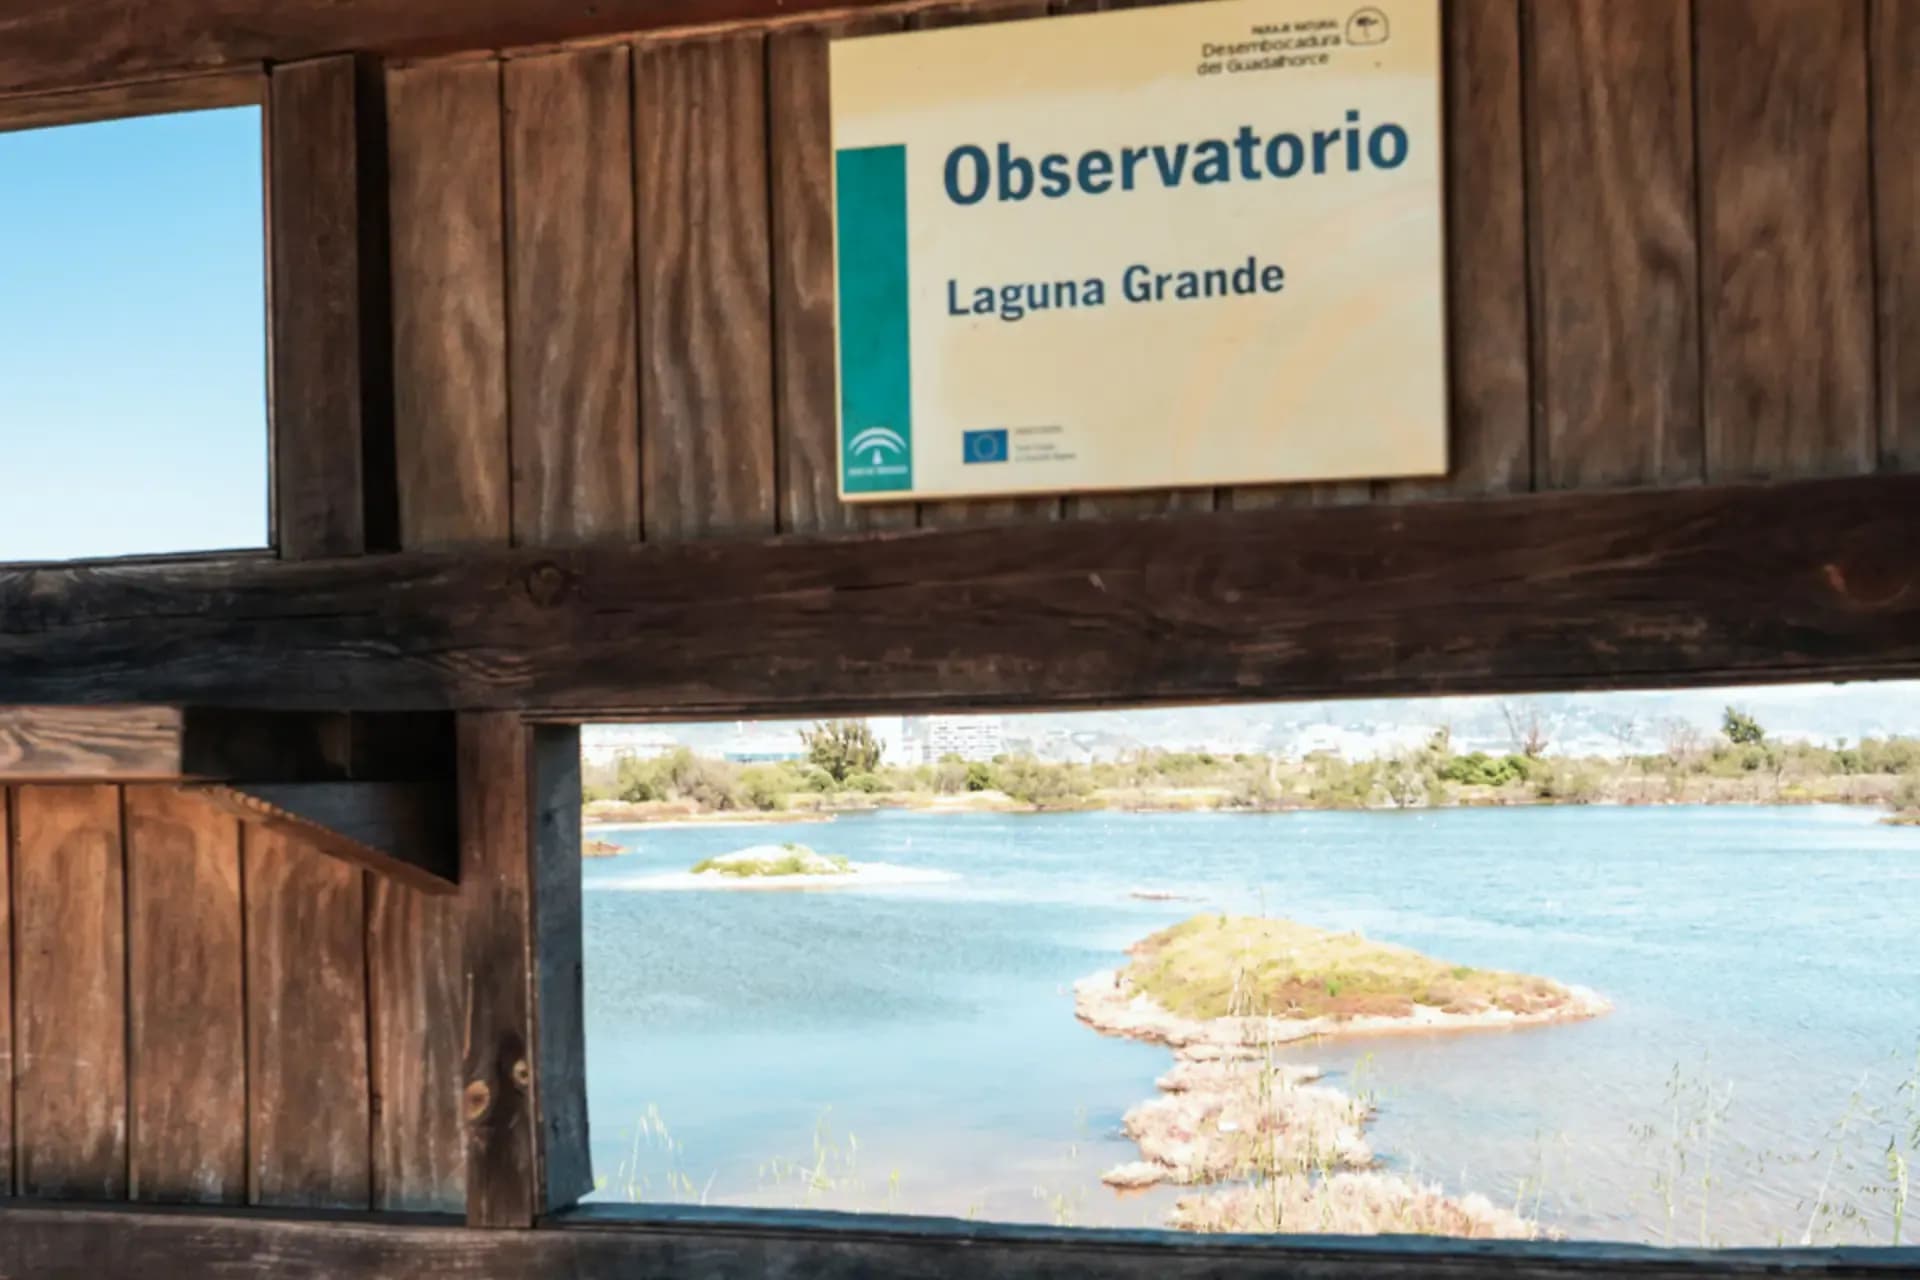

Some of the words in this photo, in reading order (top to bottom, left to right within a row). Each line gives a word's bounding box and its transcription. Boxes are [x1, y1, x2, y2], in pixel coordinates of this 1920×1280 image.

[1197, 61, 1222, 76] del
[1227, 53, 1329, 73] Guadalhorce
[1202, 35, 1341, 58] Desembocadura
[944, 109, 1408, 206] Observatorio
[947, 277, 1106, 321] Laguna
[1122, 256, 1285, 303] Grande
